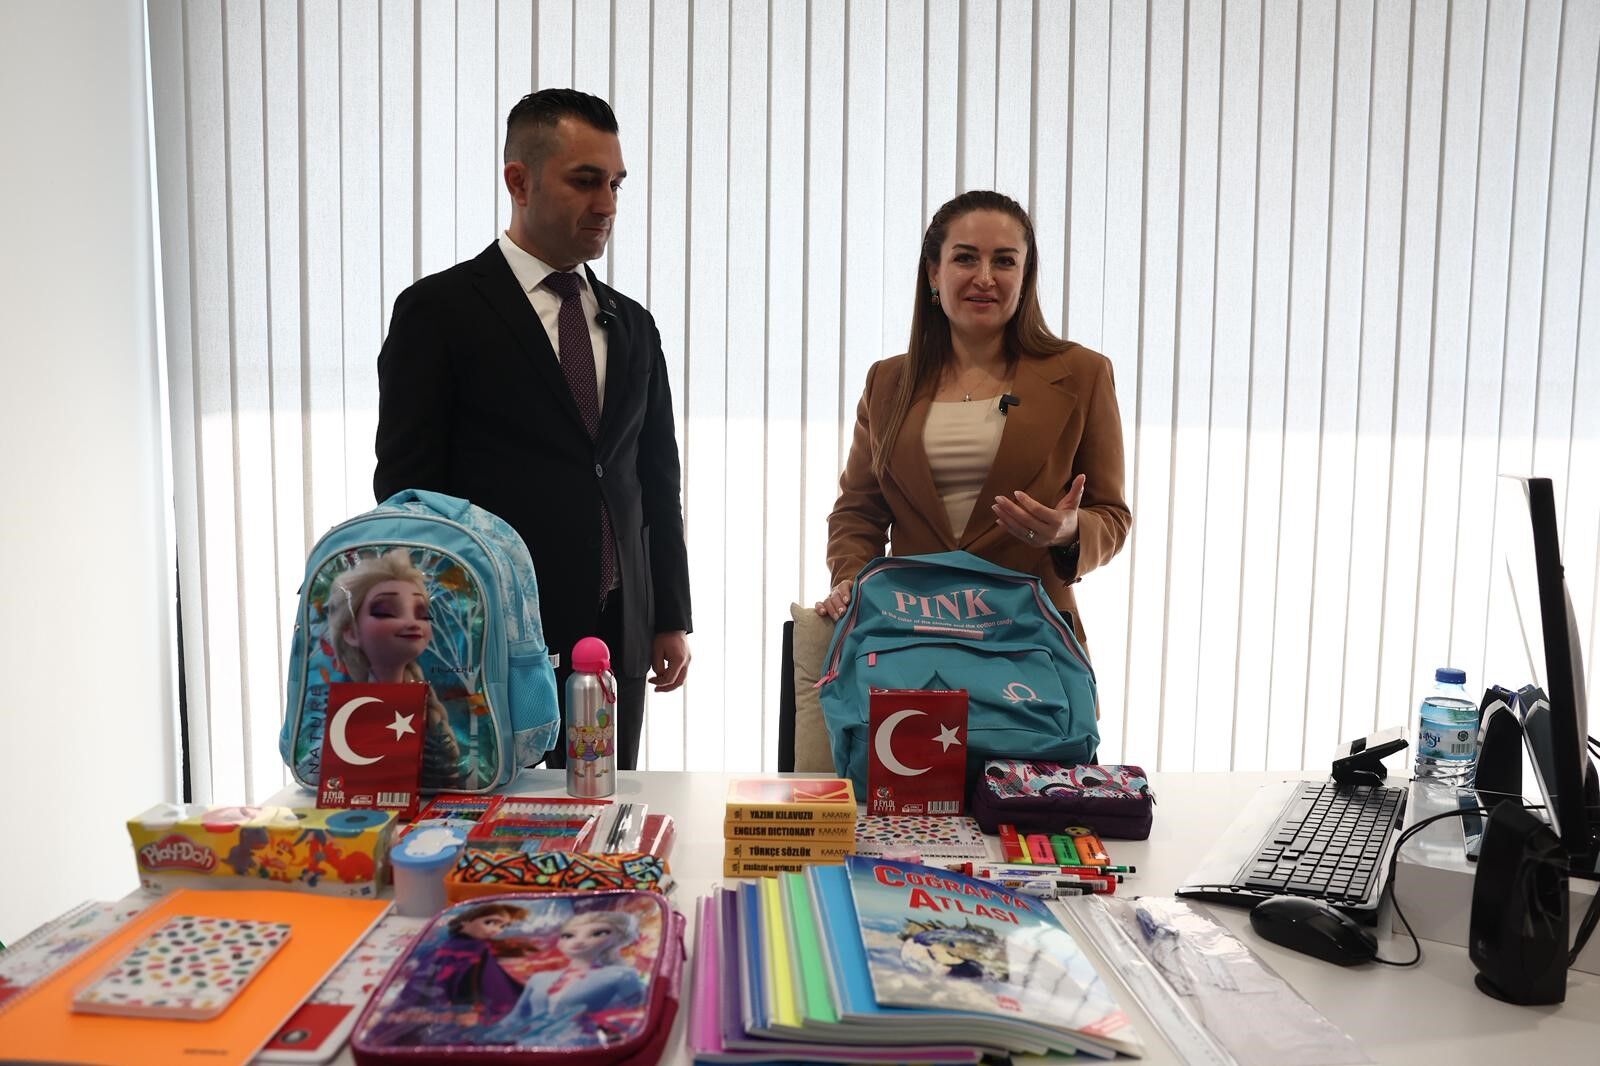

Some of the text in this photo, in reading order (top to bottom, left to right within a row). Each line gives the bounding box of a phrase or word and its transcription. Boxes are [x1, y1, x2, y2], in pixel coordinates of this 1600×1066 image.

[891, 588, 996, 621] PINK
[308, 686, 324, 775] NATURE
[734, 826, 766, 836] ENGLISH
[767, 827, 816, 836] DICTIONARY
[750, 810, 774, 820] YAZIM
[775, 810, 813, 820] KILAVUZU
[821, 811, 851, 819] KARATAY
[749, 845, 780, 858] TÜRKÇE
[781, 845, 811, 857] SÖZLÜK
[873, 864, 1033, 912] COĞRAFYA
[909, 887, 1020, 925] ATLASI
